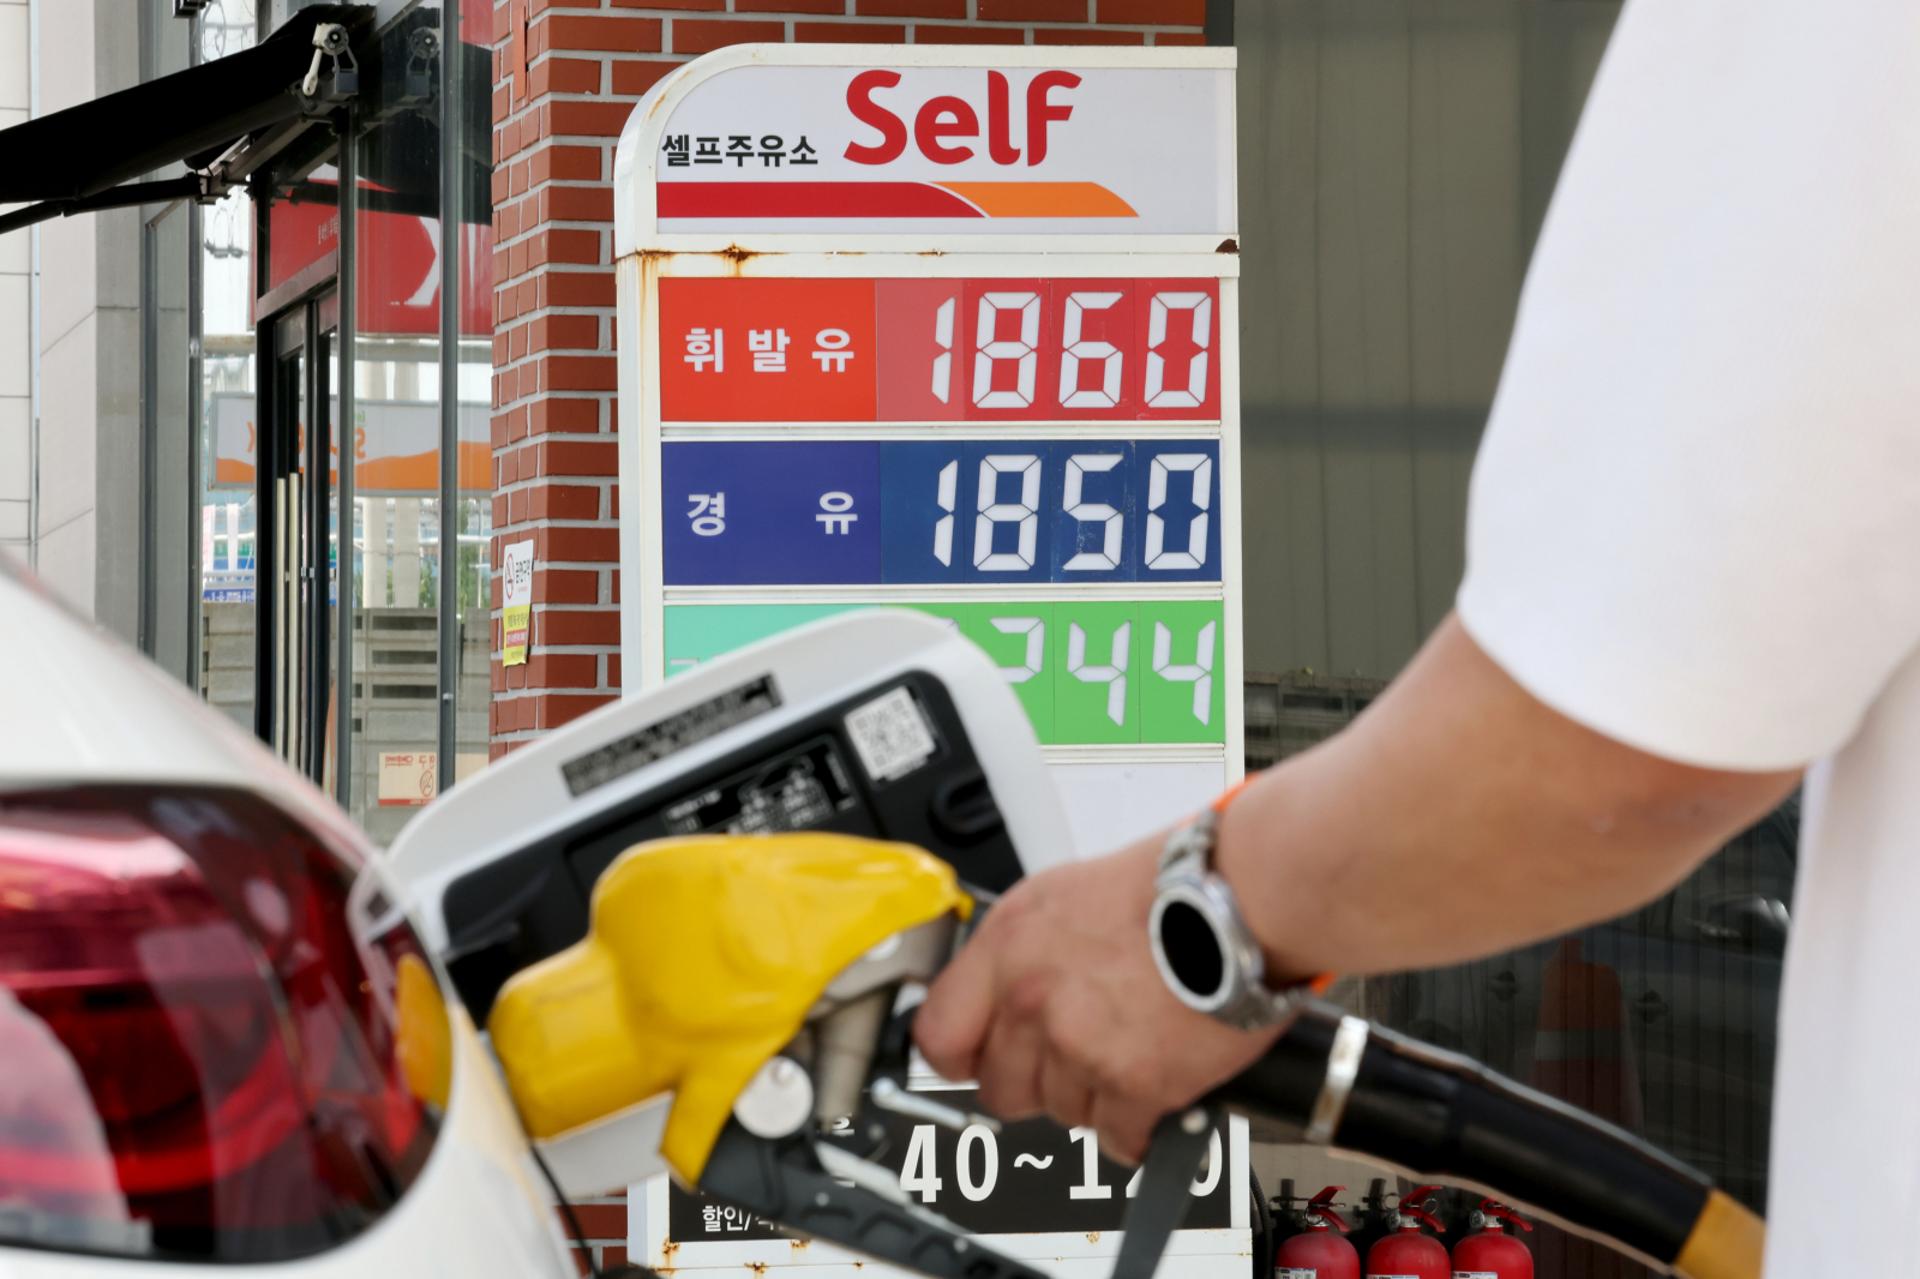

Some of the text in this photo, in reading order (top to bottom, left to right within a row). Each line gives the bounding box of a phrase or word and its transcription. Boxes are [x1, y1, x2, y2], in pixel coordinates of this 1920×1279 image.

[661, 134, 819, 168] 셀프주유소
[843, 69, 1083, 167] Self
[931, 291, 1213, 409] 1860
[933, 453, 1213, 571] 1850
[941, 616, 1216, 728] 244
